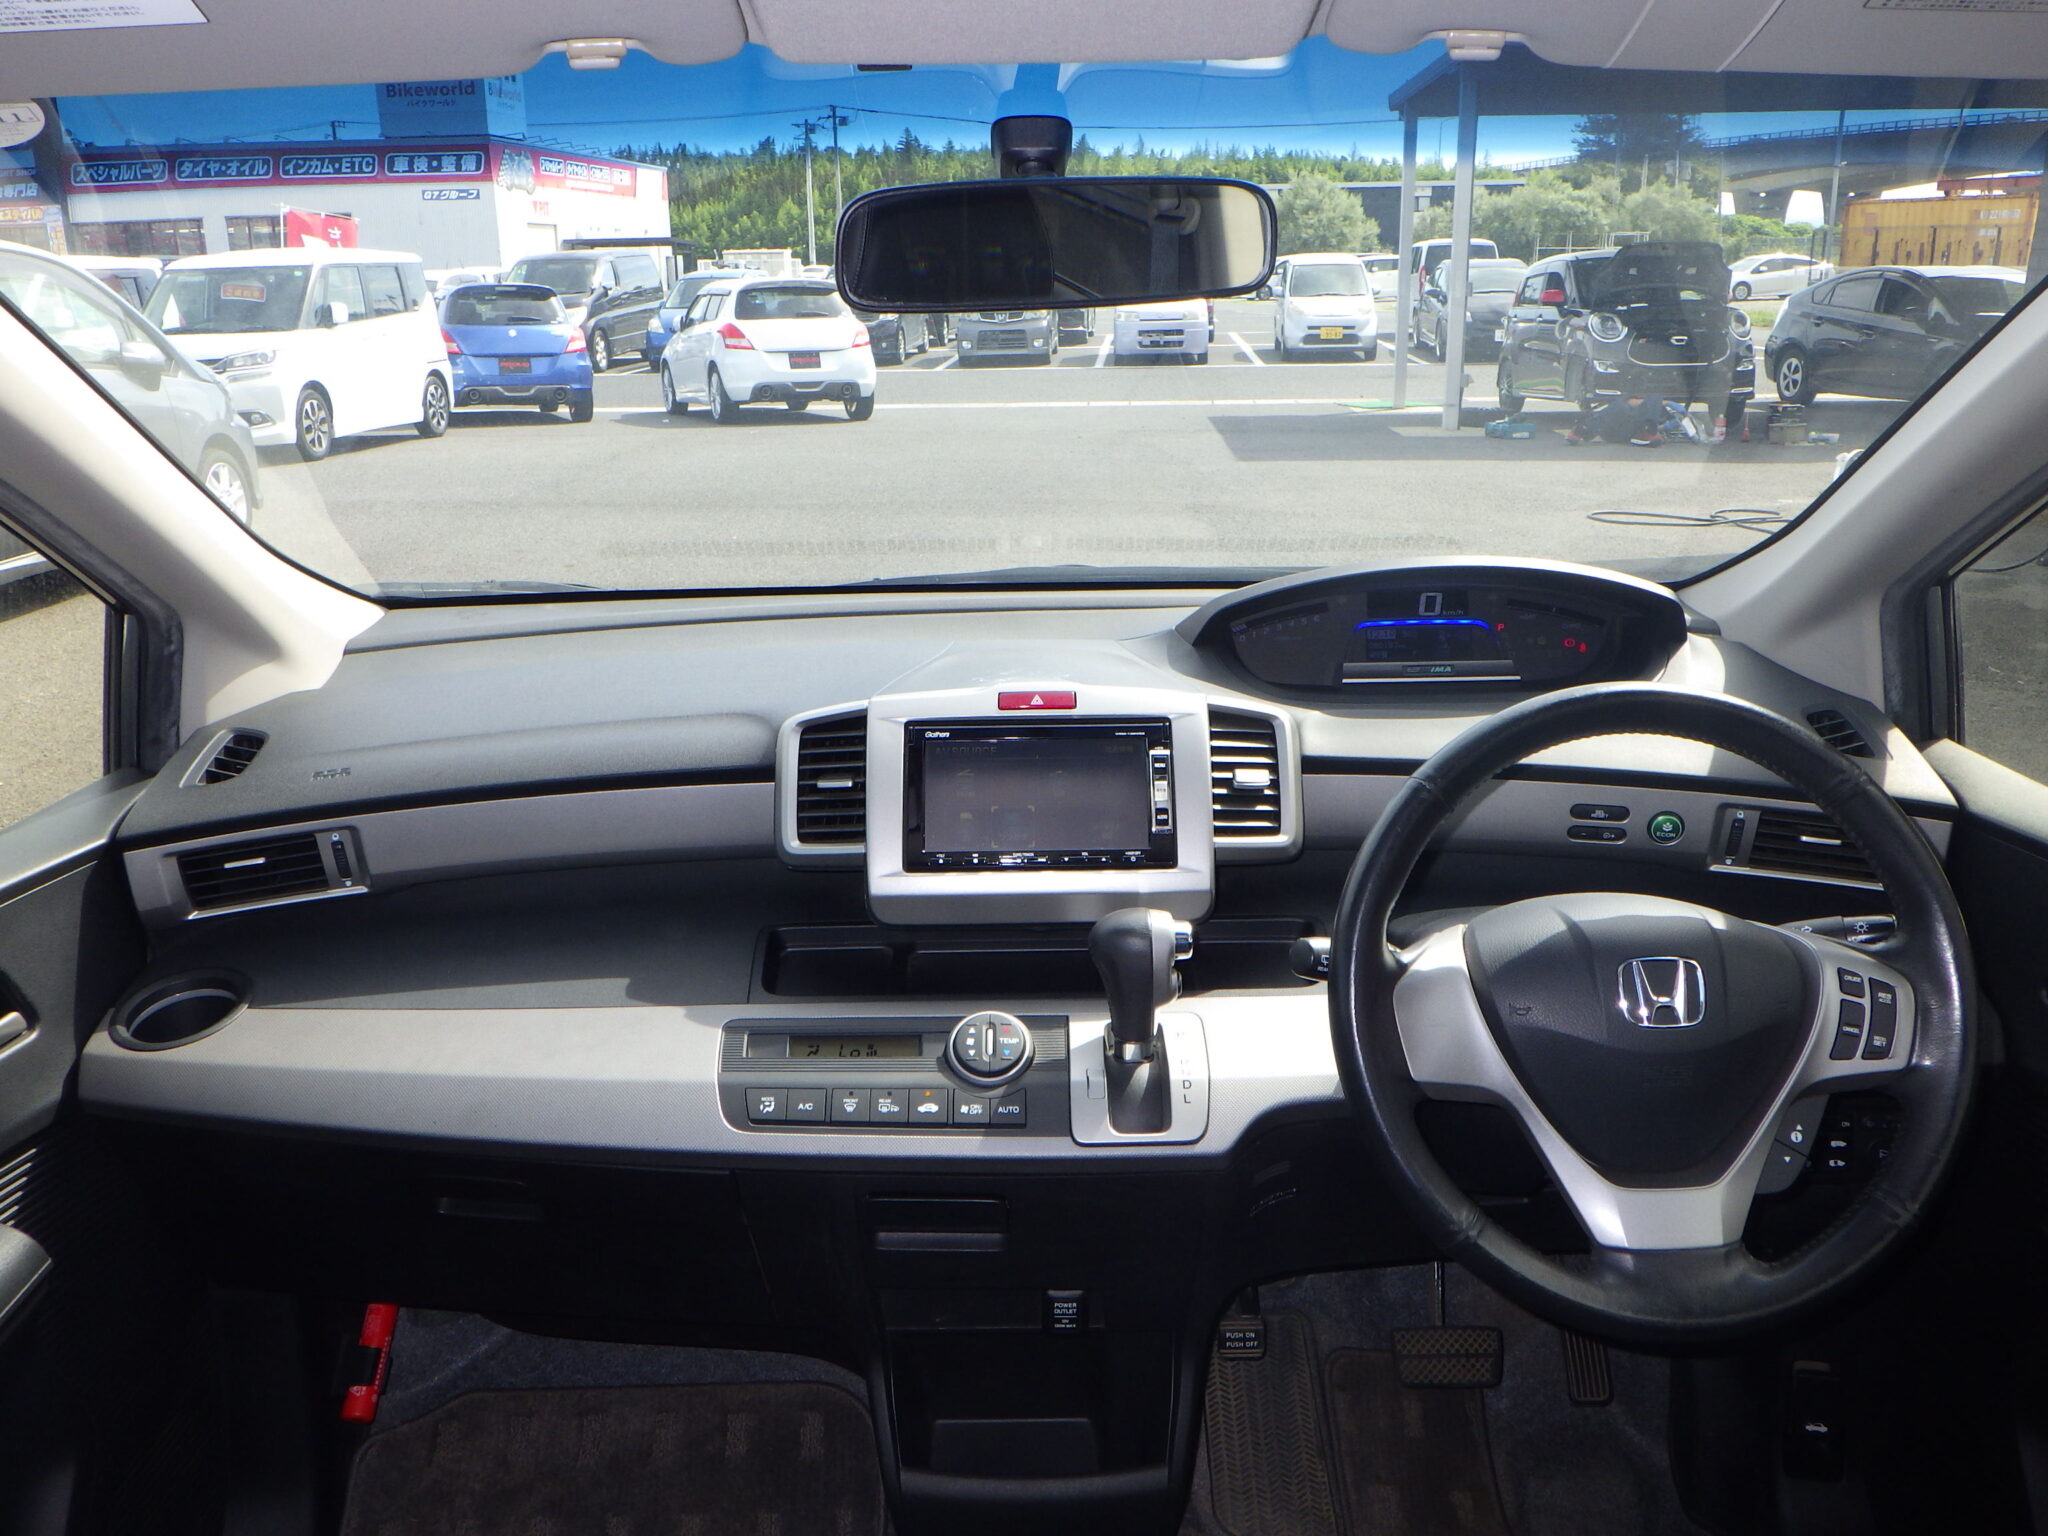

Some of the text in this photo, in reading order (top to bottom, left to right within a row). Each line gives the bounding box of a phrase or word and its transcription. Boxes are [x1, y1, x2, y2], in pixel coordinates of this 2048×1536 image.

[385, 80, 476, 98] Bikeworld
[180, 159, 268, 178] タイヤ・オイル
[284, 157, 374, 175] インカム・ETC
[393, 155, 477, 173] 車検・整備
[75, 163, 165, 182] スペシャルパーツ
[1419, 592, 1443, 616] 0
[1183, 1079, 1192, 1090] D
[1183, 1094, 1191, 1104] L
[797, 1102, 814, 1111] A/C
[997, 1106, 1020, 1114] AUTO
[1245, 1331, 1256, 1339] ON
[1245, 1340, 1259, 1348] OFF
